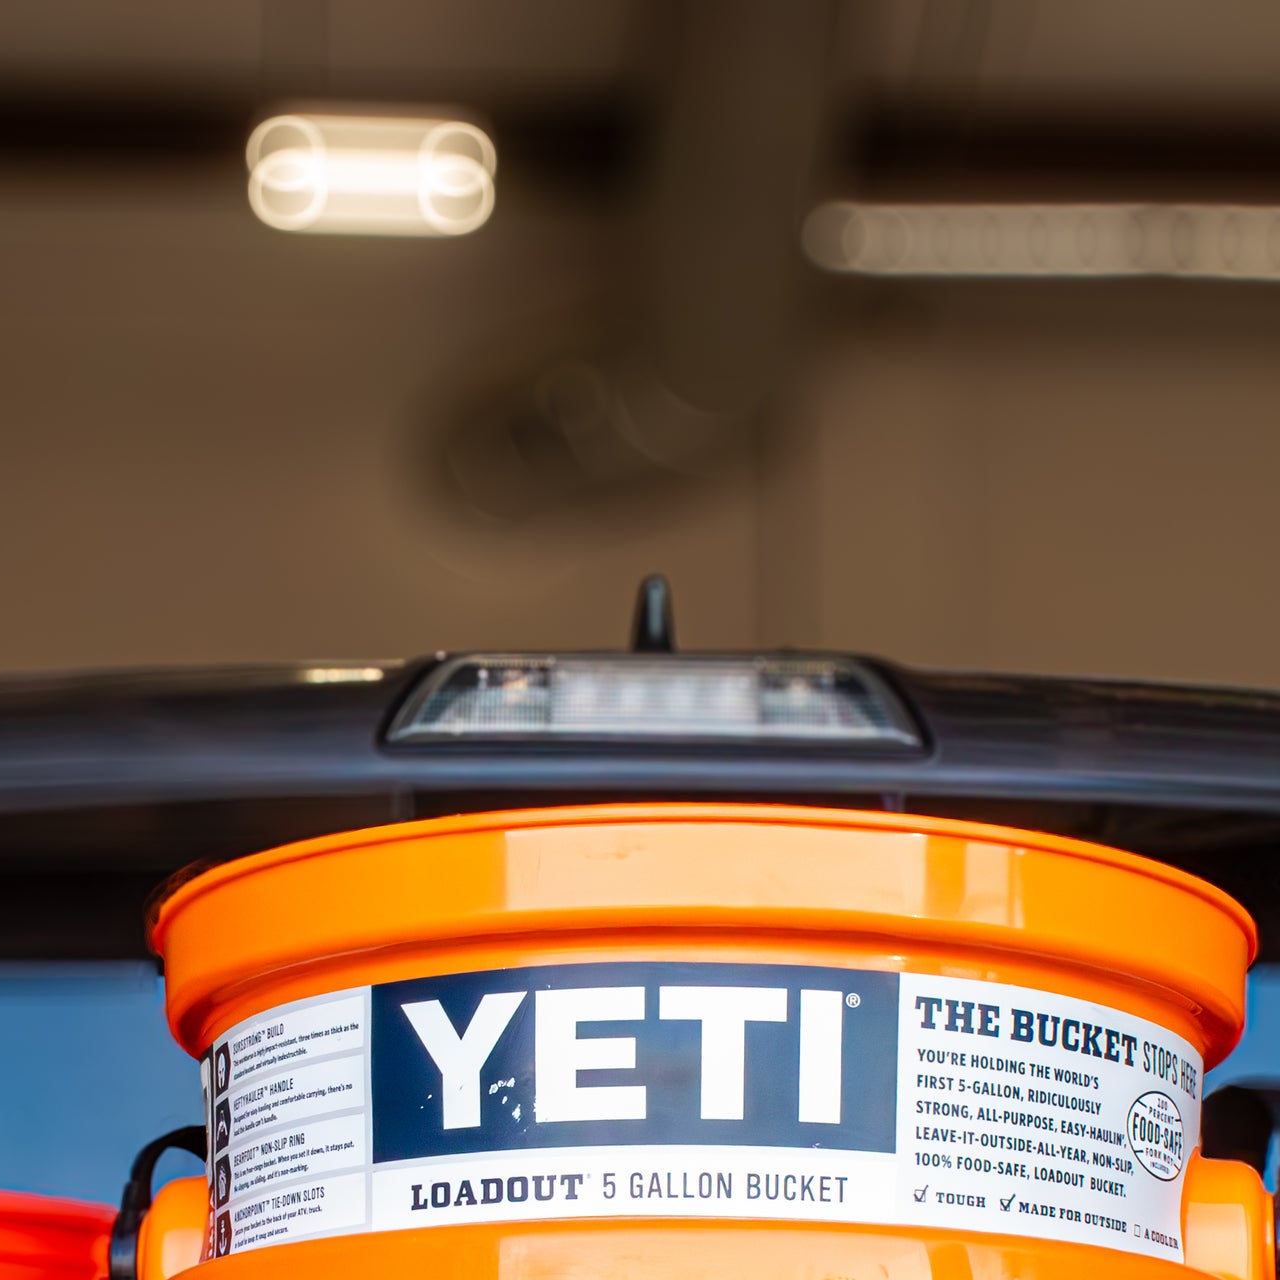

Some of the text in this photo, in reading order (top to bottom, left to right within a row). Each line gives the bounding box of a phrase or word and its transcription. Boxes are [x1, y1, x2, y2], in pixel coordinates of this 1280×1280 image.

[267, 1023, 284, 1039] BUILD
[298, 1034, 310, 1042] three
[311, 1030, 324, 1039] times
[331, 1025, 343, 1034] thick
[350, 1022, 359, 1030] the
[915, 996, 1000, 1038] THE
[1010, 1008, 1137, 1067] BUCKET
[1143, 1041, 1178, 1085] STOPS
[917, 1048, 1099, 1089] YOU'RE HOLDING THE WORLD'S
[269, 1078, 293, 1095] HANDLE
[279, 1092, 306, 1105] comfortable
[306, 1088, 326, 1099] carrying,
[327, 1083, 345, 1094] there's
[917, 1074, 1101, 1115] FIRST 5-GALLON, RIDICULOUSLY
[915, 1100, 973, 1120] STRONG,
[977, 1107, 1058, 1133] ALL-PURPOSE,
[1148, 1106, 1174, 1125] PERCENT
[260, 1137, 287, 1156] NON-SLIP
[289, 1133, 305, 1147] RING
[1132, 1112, 1182, 1160] FOOD-SAFE
[278, 1155, 289, 1163] When
[290, 1153, 298, 1161] you
[311, 1147, 325, 1156] down,
[330, 1143, 343, 1152] stays
[344, 1141, 354, 1150] put.
[915, 1126, 1134, 1176] LEAVE-IT-OUTSIDE-ALL-YEAR, NON-SLIP,
[1145, 1147, 1174, 1166] FORK NOT
[915, 1152, 1126, 1198] 100% FOOD-SAFE, LOADOUT BUCKET.
[271, 1191, 301, 1209] TIE-DOWN
[303, 1186, 325, 1202] SLOTS
[411, 1172, 848, 1211] LOADOUT 5 GALLON BUCKET
[273, 1213, 282, 1222] back
[282, 1212, 287, 1220] of
[287, 1211, 297, 1220] your
[297, 1207, 308, 1216] ATV,
[308, 1205, 322, 1214] truck.
[936, 1192, 1179, 1249] TOUGH MADE FOR OUTSIDE A COOLER
